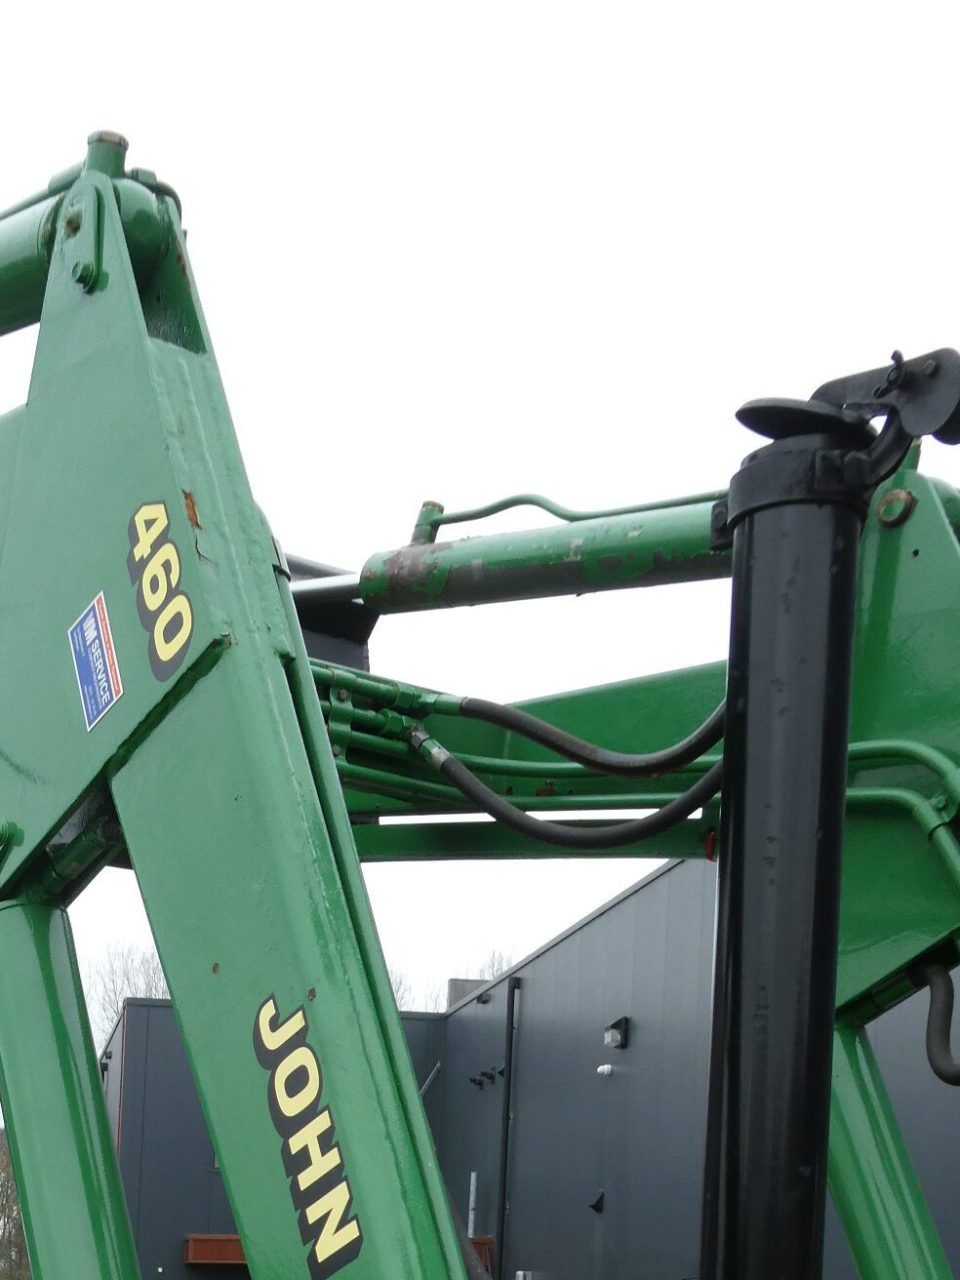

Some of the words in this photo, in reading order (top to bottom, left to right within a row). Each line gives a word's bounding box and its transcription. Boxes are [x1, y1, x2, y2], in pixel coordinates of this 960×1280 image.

[131, 502, 193, 664] 460
[90, 640, 111, 706] SERVICE
[257, 996, 361, 1268] JOHN
